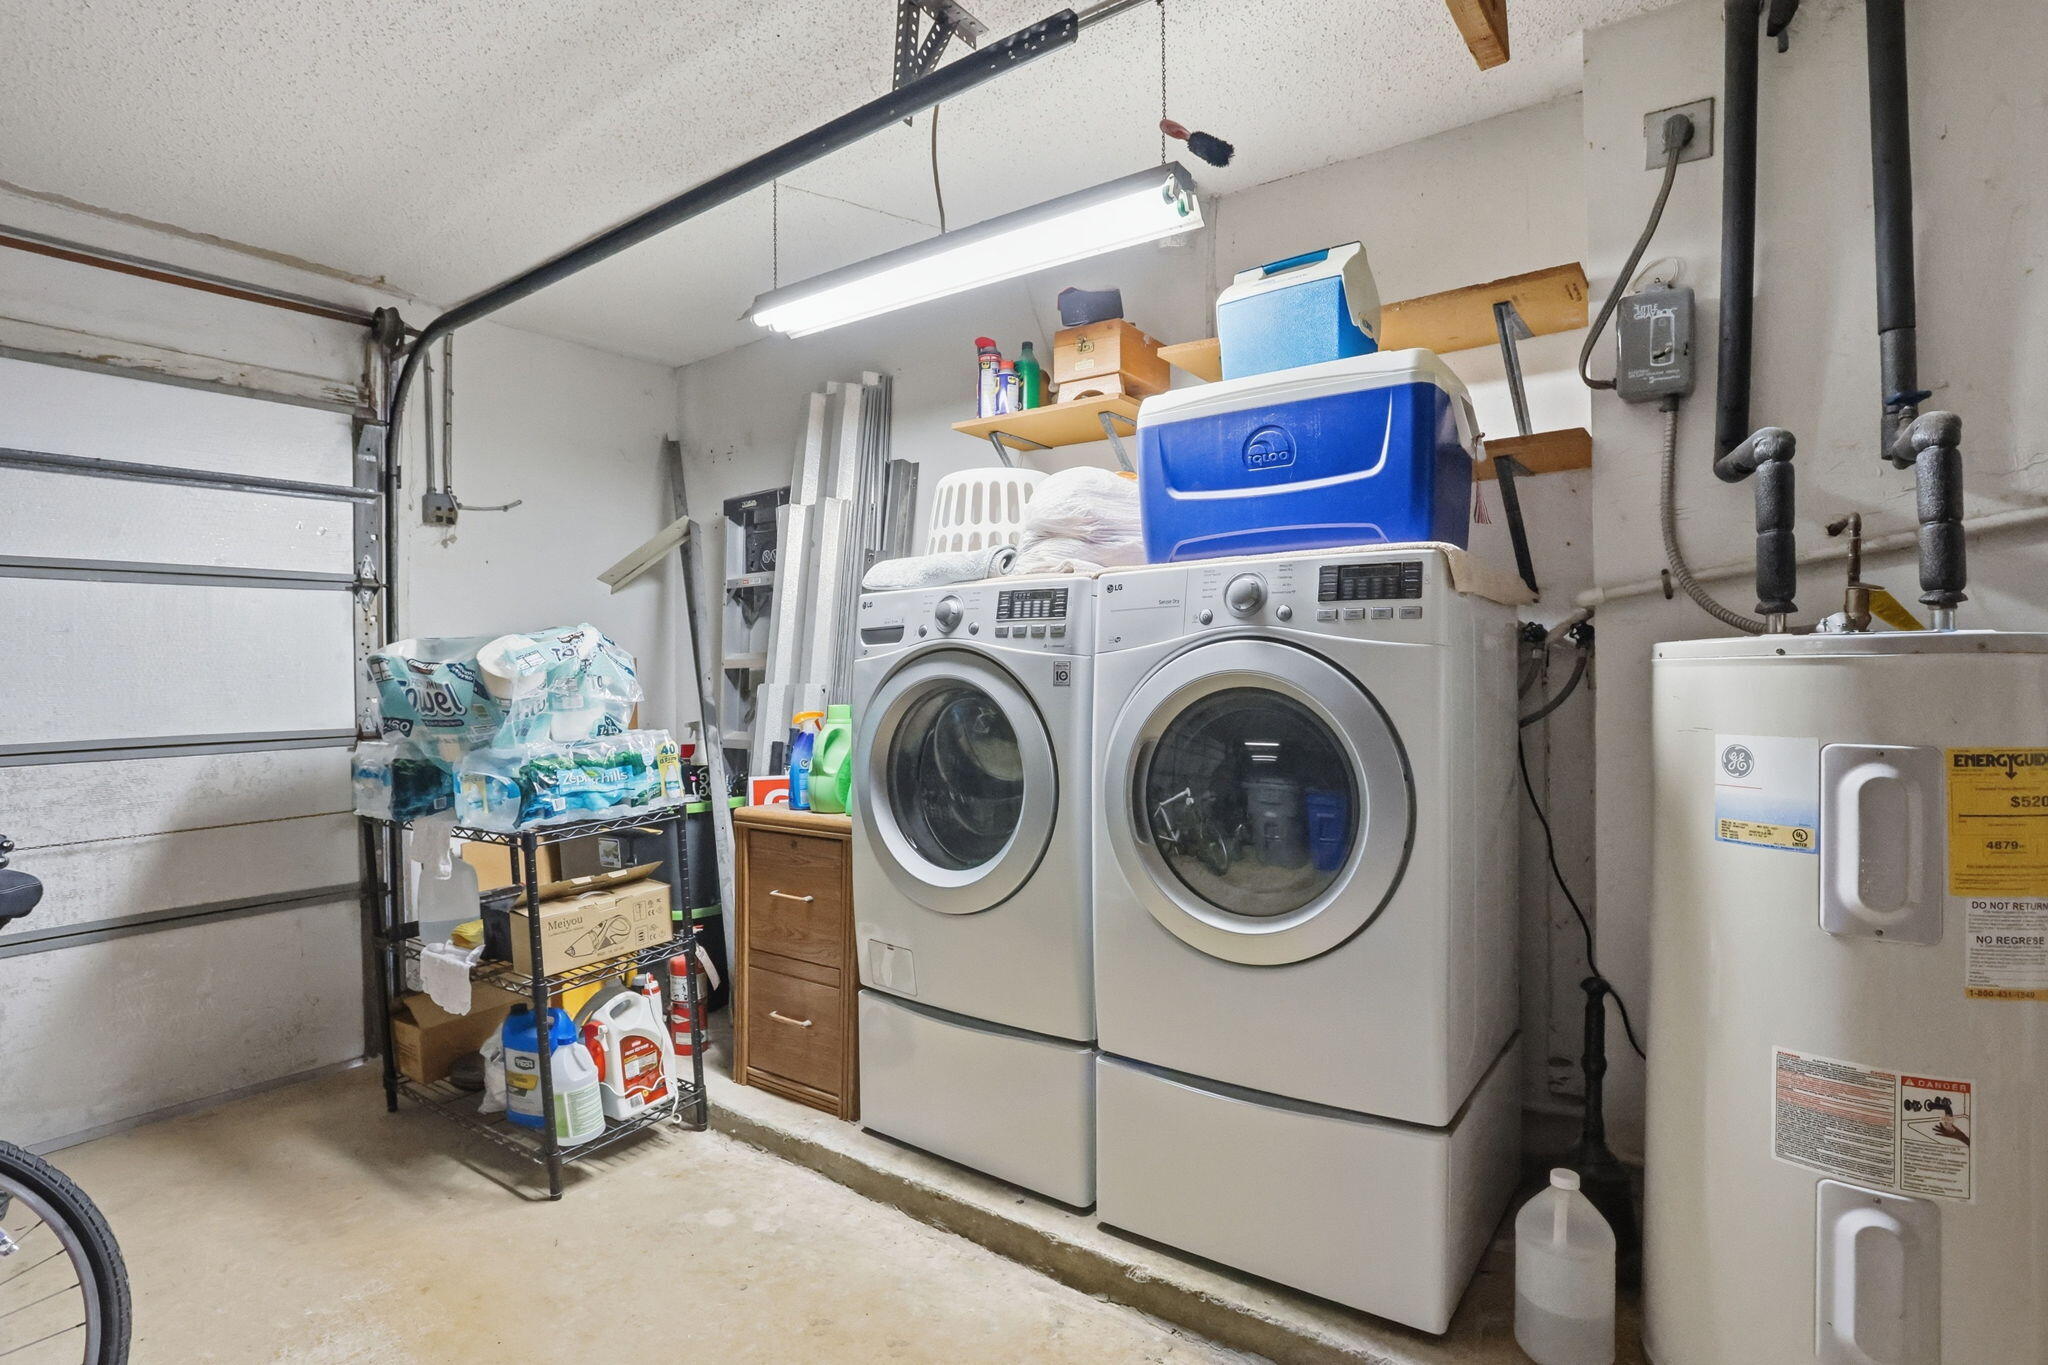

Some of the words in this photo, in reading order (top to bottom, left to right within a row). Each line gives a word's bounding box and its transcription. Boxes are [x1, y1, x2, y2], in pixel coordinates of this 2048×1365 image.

[1248, 450, 1288, 466] IGLOO
[397, 680, 467, 717] owel
[660, 744, 675, 755] 40
[1953, 753, 2048, 768] ENERGYGUID
[1986, 840, 2019, 850] 4879
[1971, 901, 1987, 910] DO
[1989, 902, 2010, 911] NOT
[2012, 902, 2048, 911] RETURN
[547, 916, 583, 932] Meiyou
[1976, 935, 1993, 945] NO
[1996, 936, 2045, 945] REGRESE
[1918, 1081, 1968, 1093] DANGER
